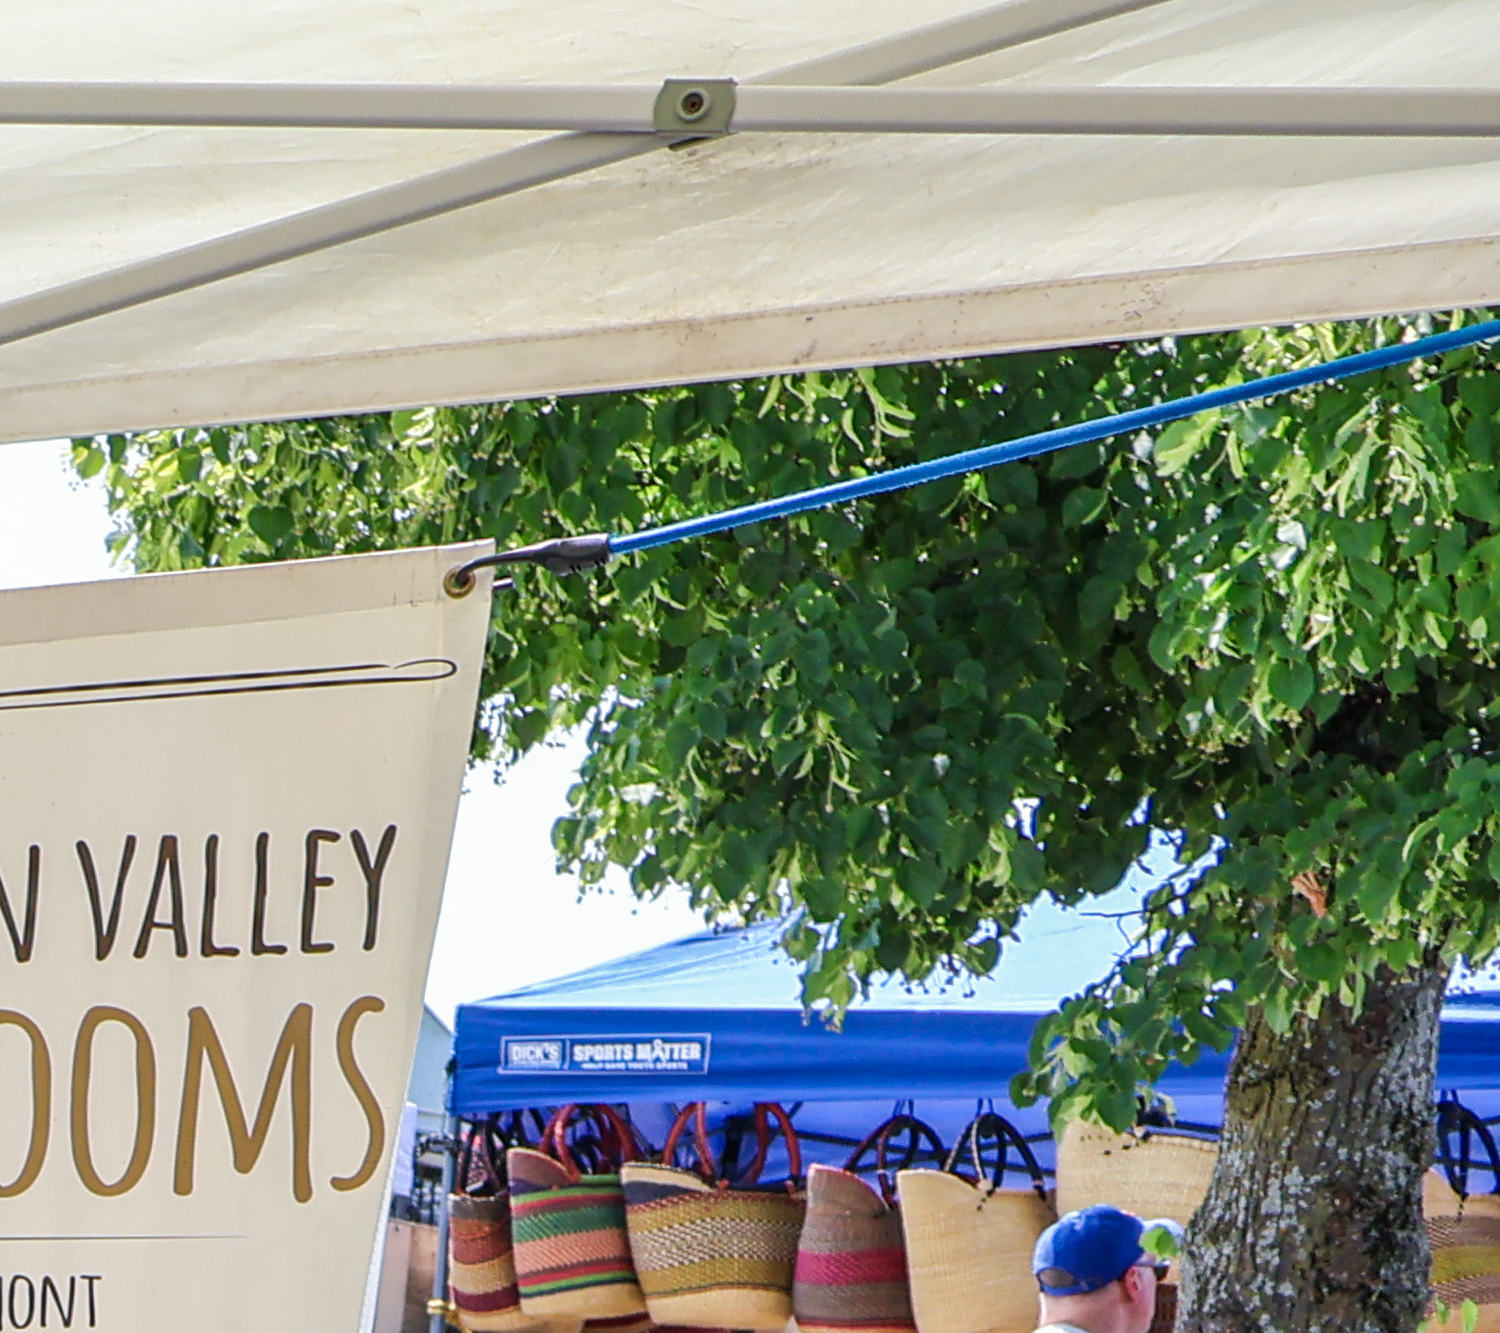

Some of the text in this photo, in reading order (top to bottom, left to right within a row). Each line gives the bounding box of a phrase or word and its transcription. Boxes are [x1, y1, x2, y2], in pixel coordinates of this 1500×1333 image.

[76, 823, 397, 963] VALLEY
[573, 1045, 633, 1061] SPORTS
[636, 1039, 701, 1062] MATTER
